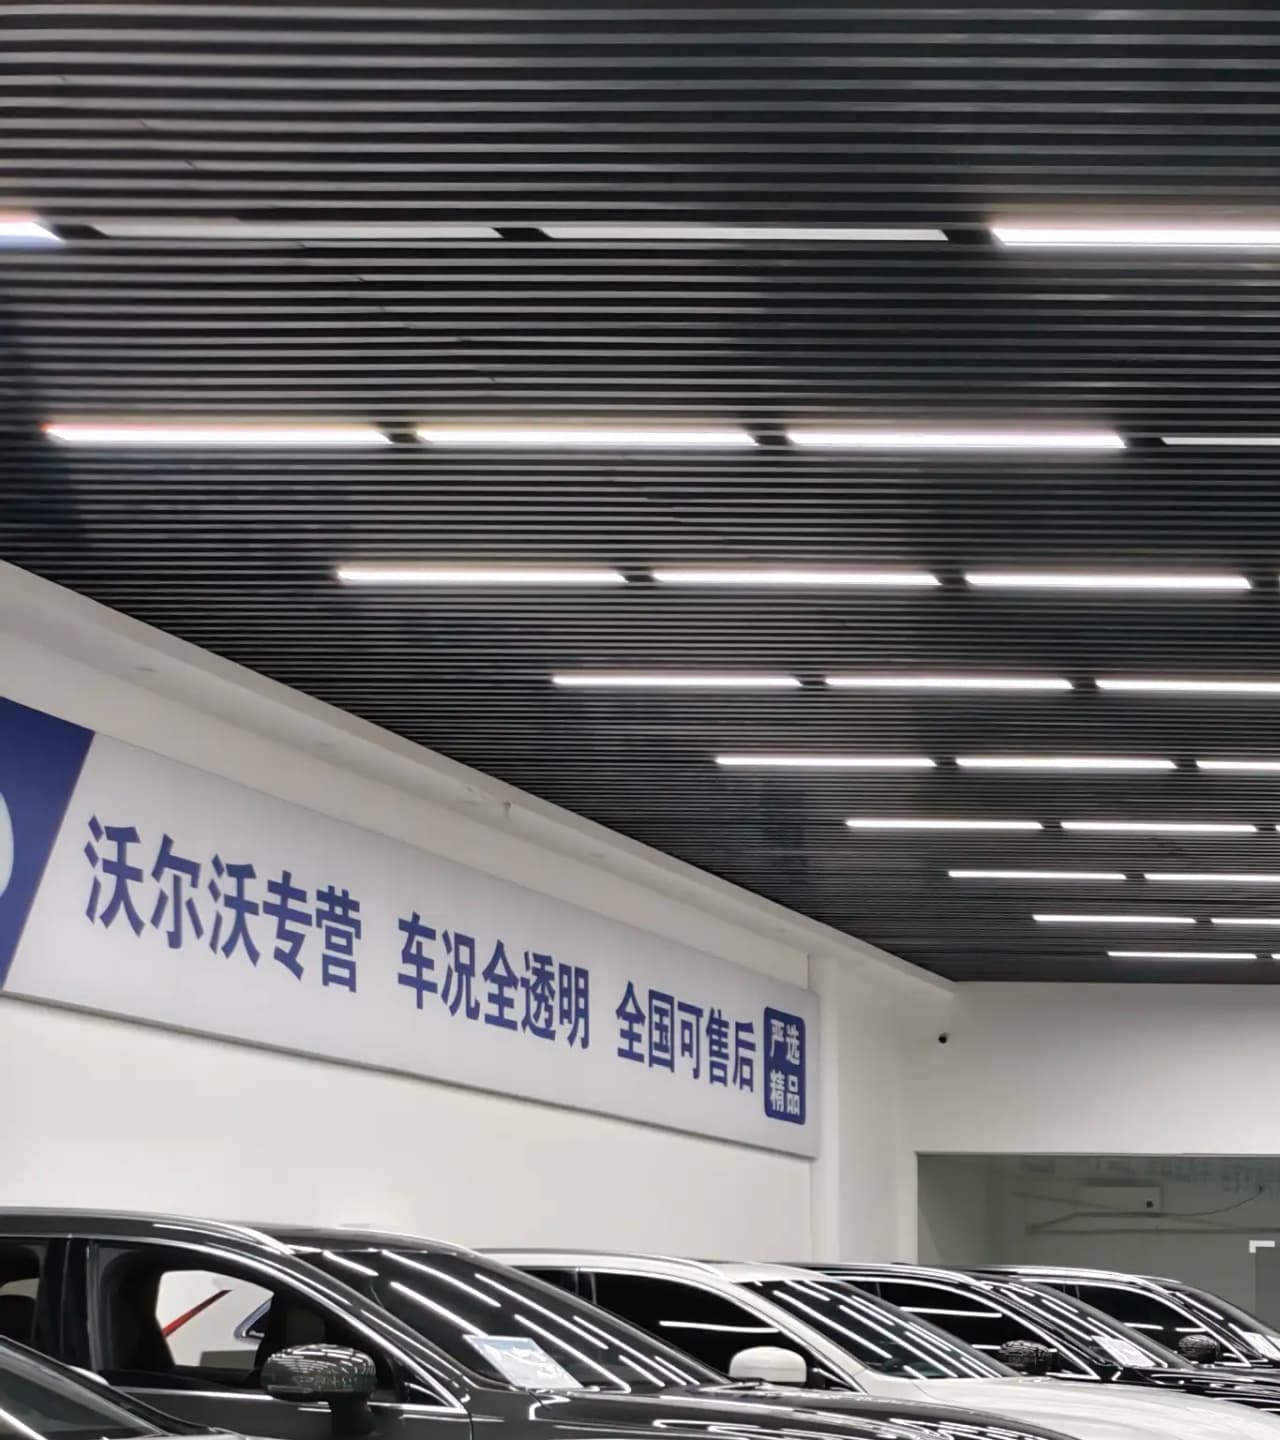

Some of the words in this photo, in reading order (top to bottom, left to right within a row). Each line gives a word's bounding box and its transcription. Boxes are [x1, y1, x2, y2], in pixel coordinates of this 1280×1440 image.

[83, 814, 362, 993] 沃尔沃专营
[398, 911, 590, 1050] 车况全透明
[615, 980, 757, 1093] 全国可售后
[770, 1018, 801, 1066] 严选
[769, 1069, 801, 1117] 精品
